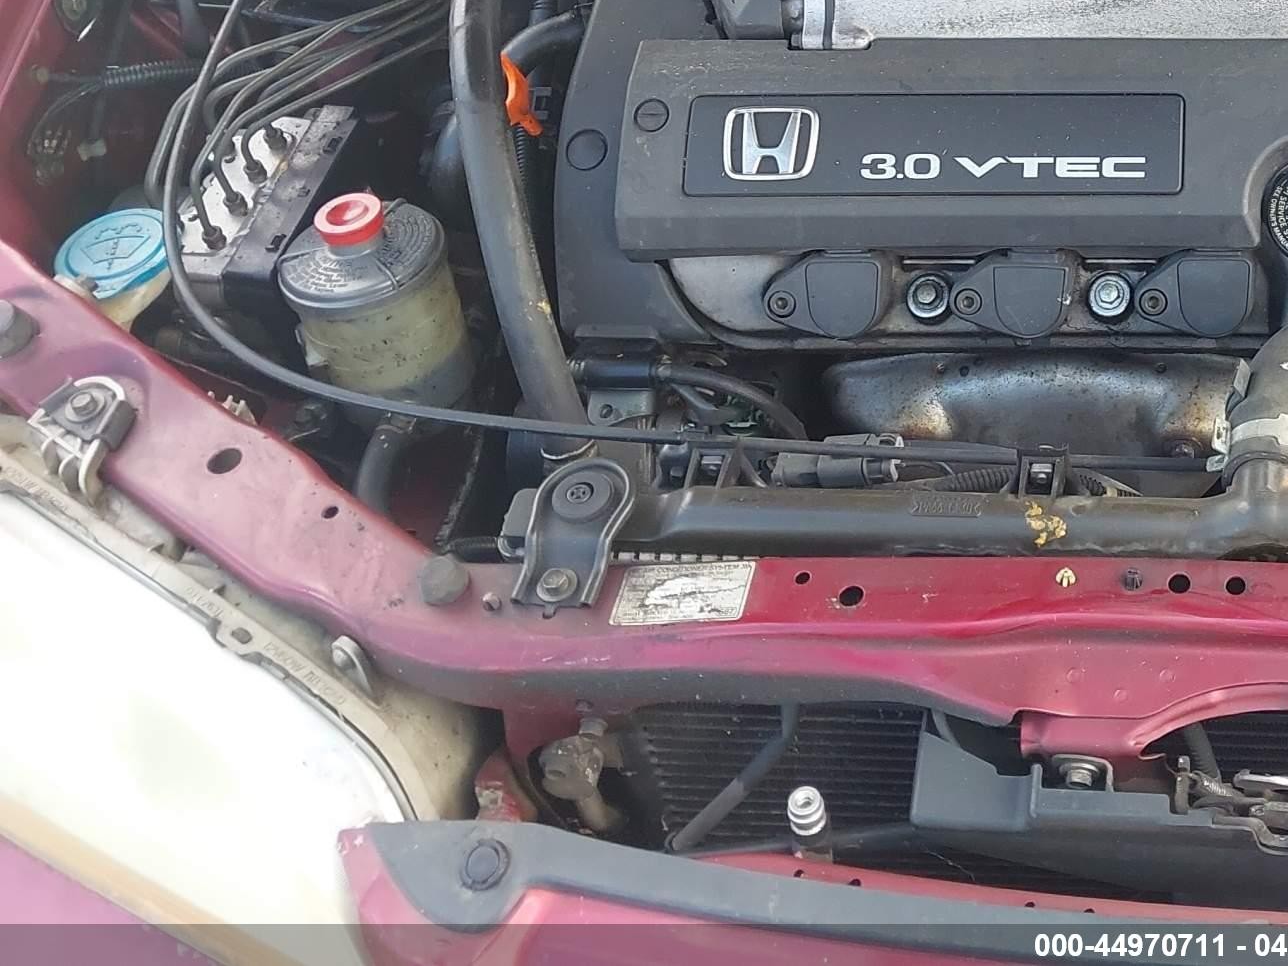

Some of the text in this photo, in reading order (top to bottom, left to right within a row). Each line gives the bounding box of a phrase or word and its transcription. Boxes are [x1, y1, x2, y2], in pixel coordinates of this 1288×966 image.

[859, 153, 1147, 179] 3.0 VTEC
[1277, 196, 1287, 228] SERVICE
